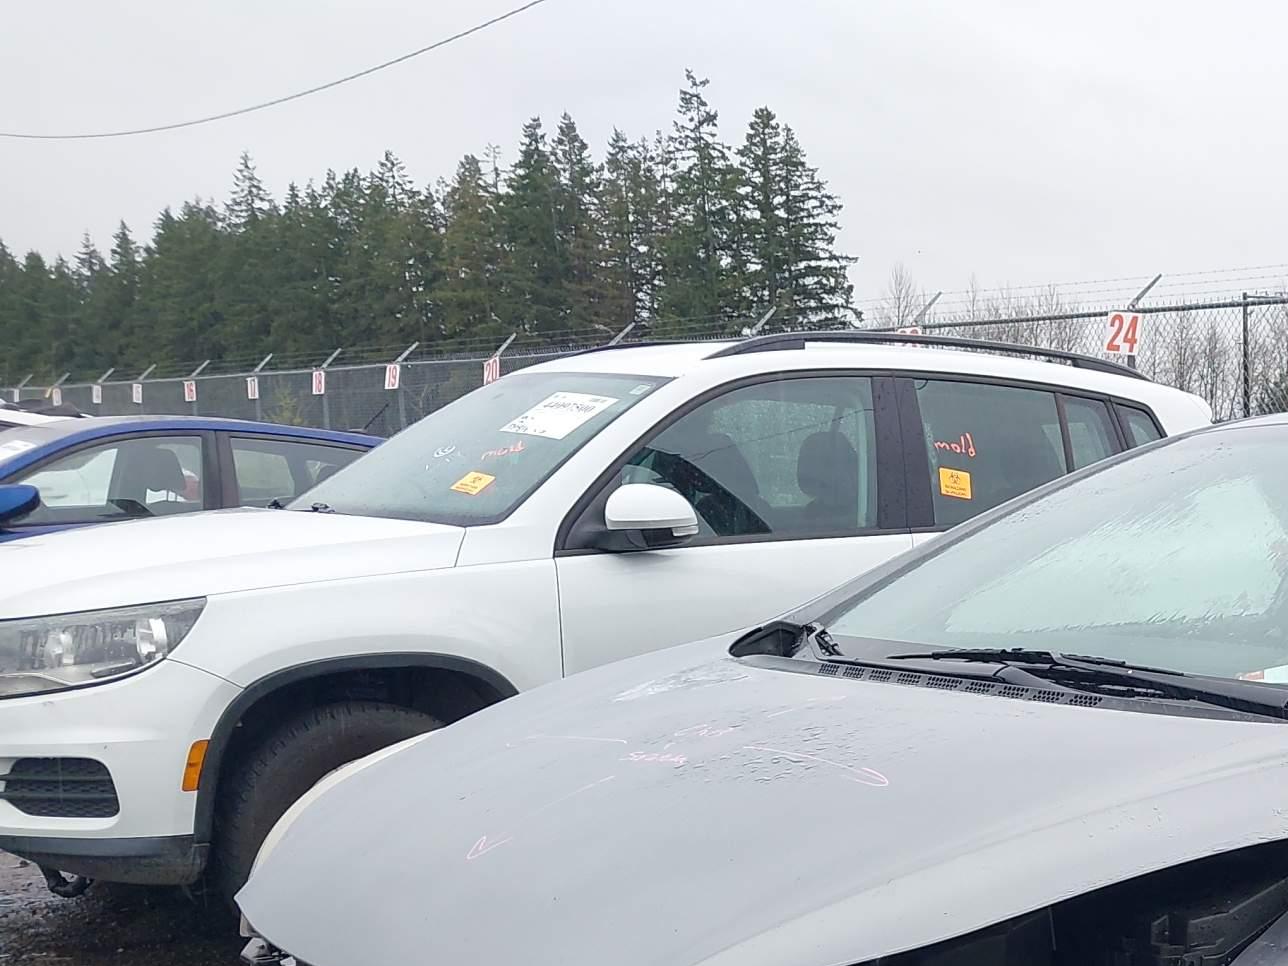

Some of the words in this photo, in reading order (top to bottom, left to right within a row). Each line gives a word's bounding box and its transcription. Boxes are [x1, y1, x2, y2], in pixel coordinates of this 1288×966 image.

[1106, 314, 1138, 353] 24
[388, 365, 398, 388] 19
[485, 358, 498, 384] 20
